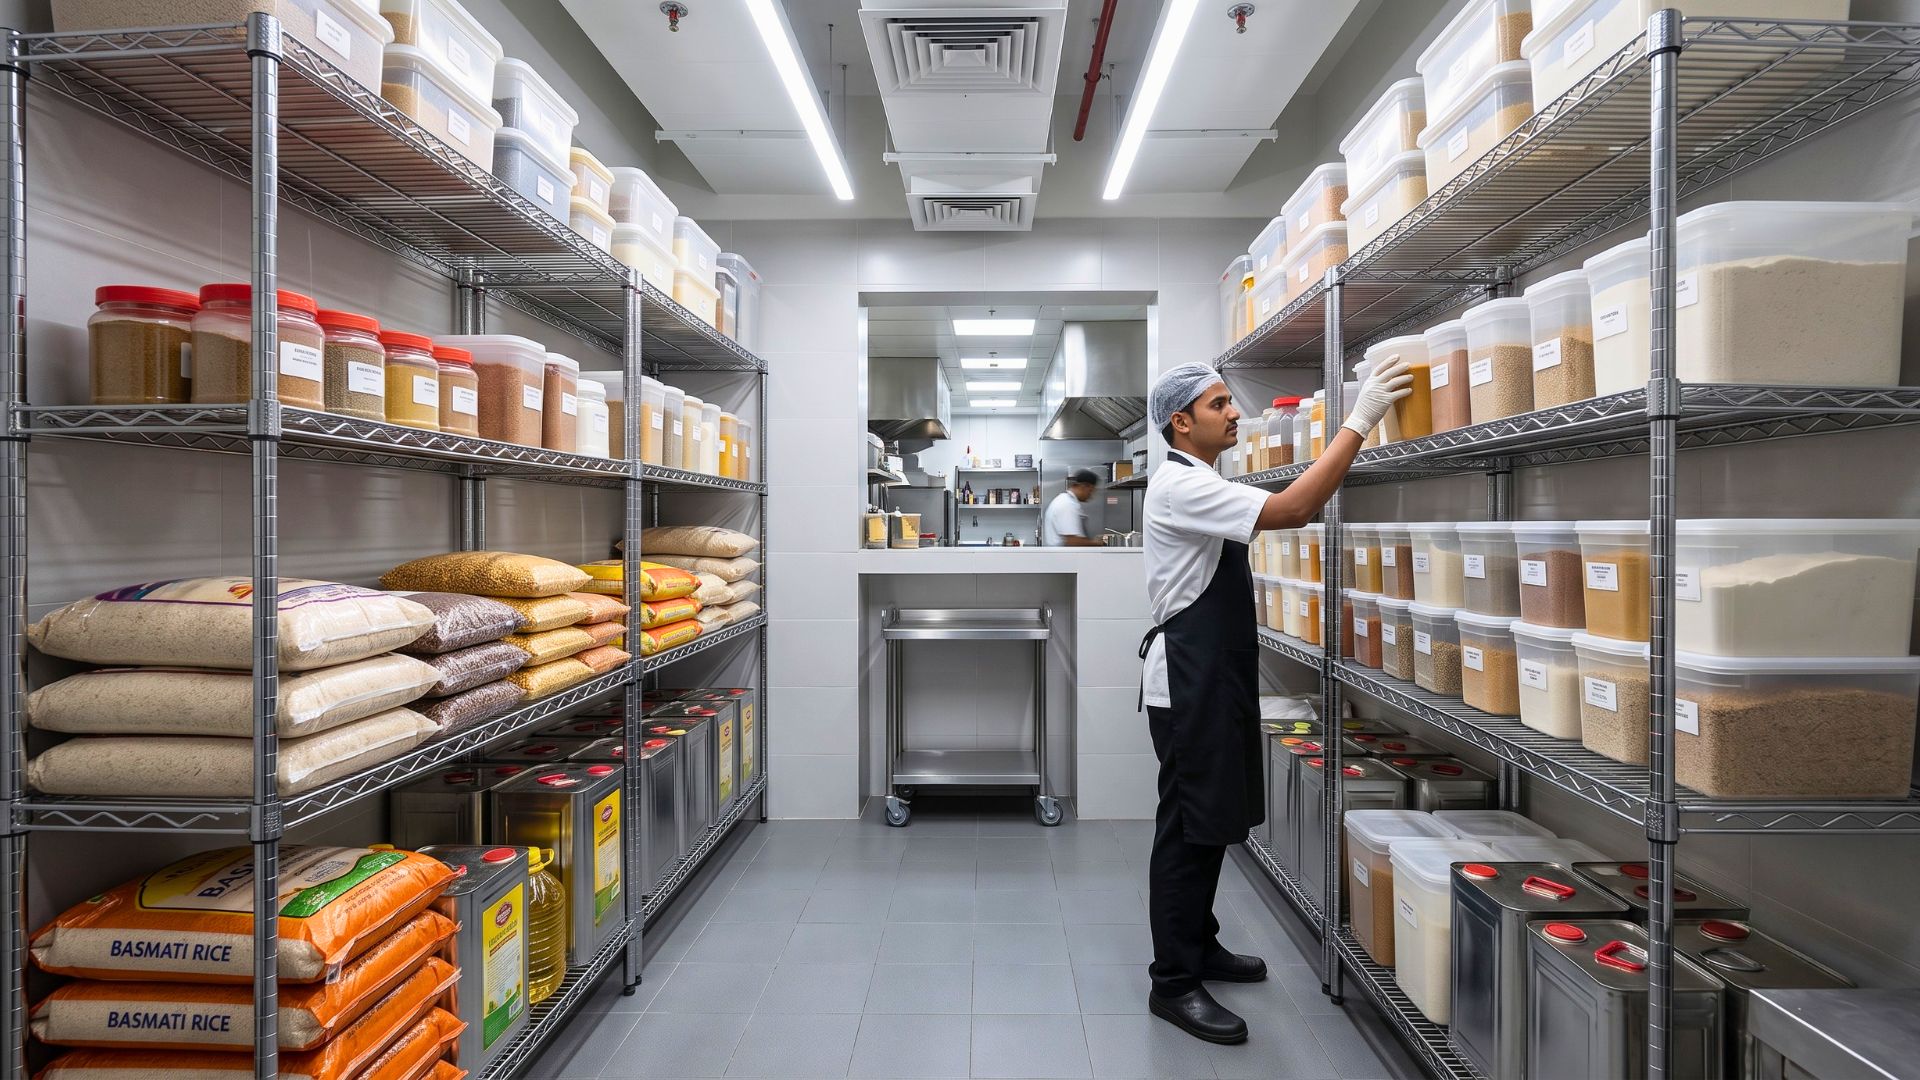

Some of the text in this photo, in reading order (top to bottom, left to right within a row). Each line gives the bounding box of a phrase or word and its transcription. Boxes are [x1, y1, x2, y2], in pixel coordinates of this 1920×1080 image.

[197, 863, 254, 897] BAS
[110, 940, 232, 962] BASMATI RICE
[107, 1011, 231, 1032] BASMATI RICE
